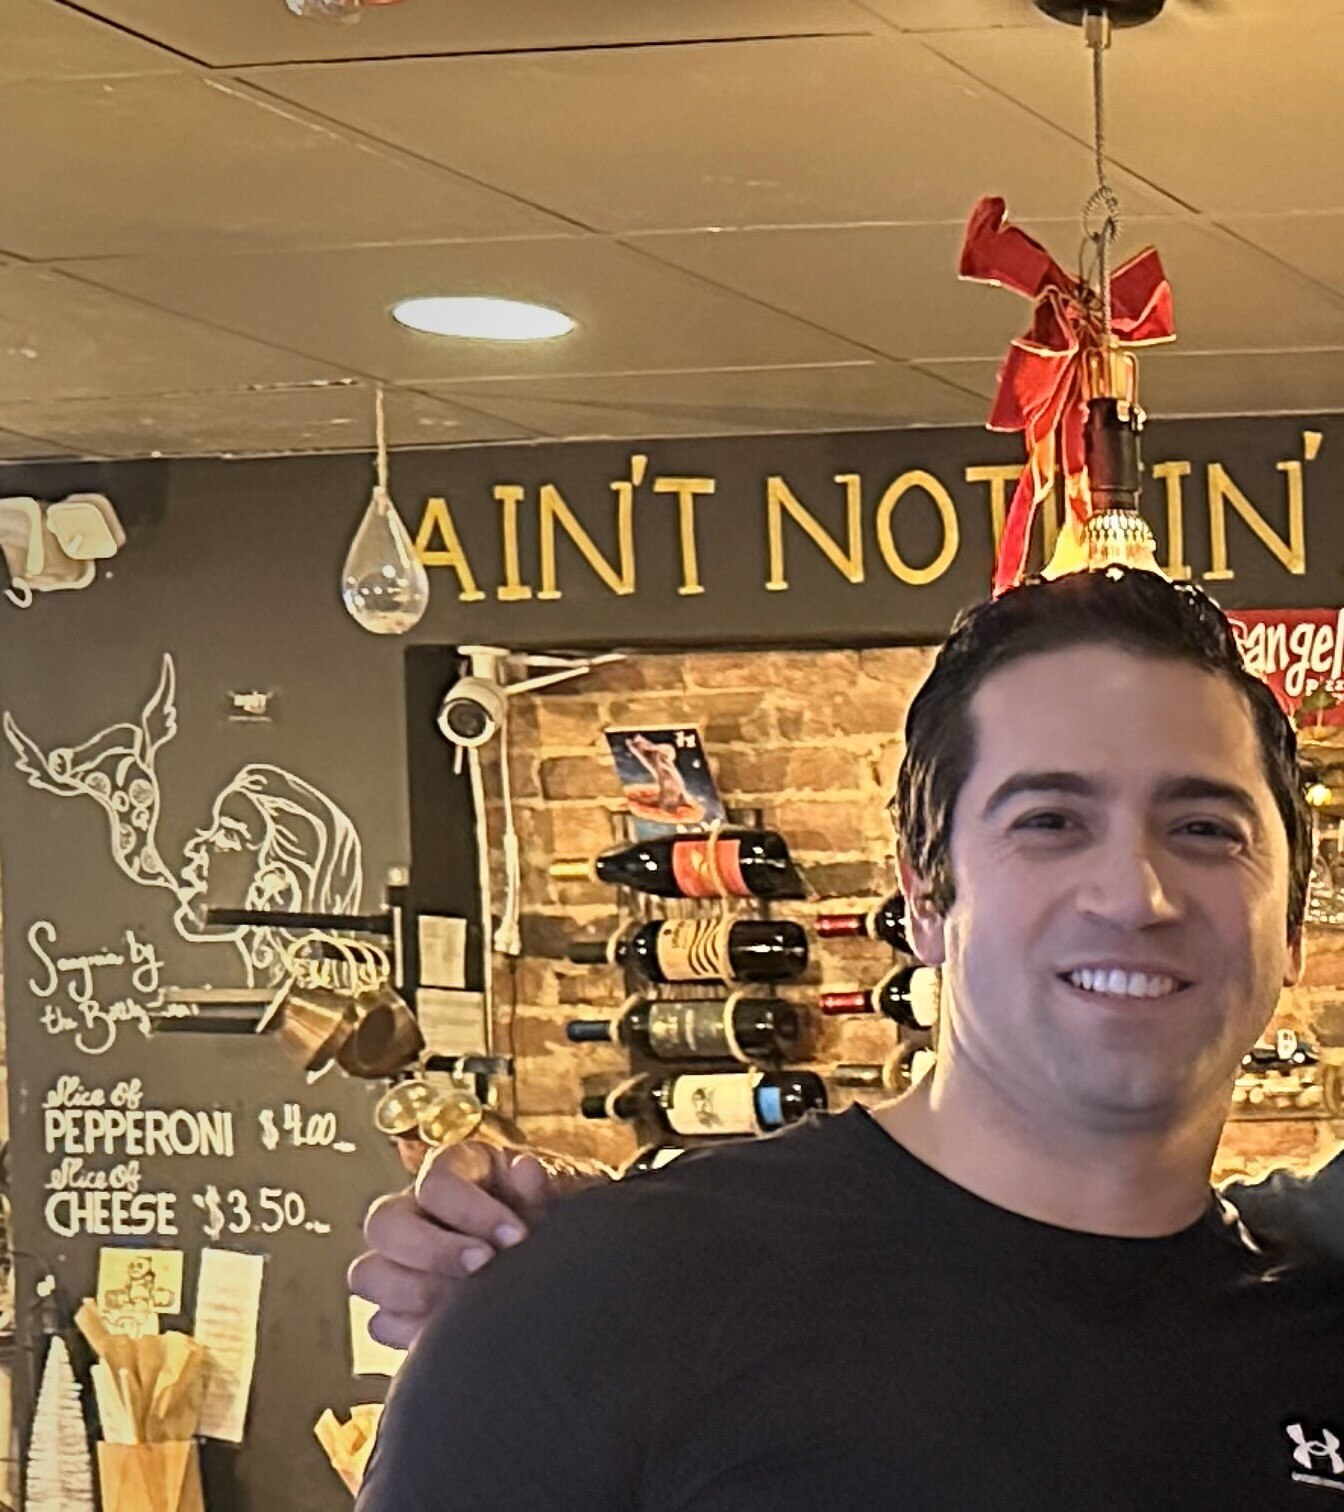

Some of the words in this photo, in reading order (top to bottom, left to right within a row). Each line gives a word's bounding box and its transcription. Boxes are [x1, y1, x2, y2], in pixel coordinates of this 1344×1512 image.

[413, 455, 716, 601] AIN'T
[763, 431, 1323, 591] NOTIN'
[45, 1109, 235, 1157] PEPPERONI
[45, 1190, 179, 1238] CHEESE
